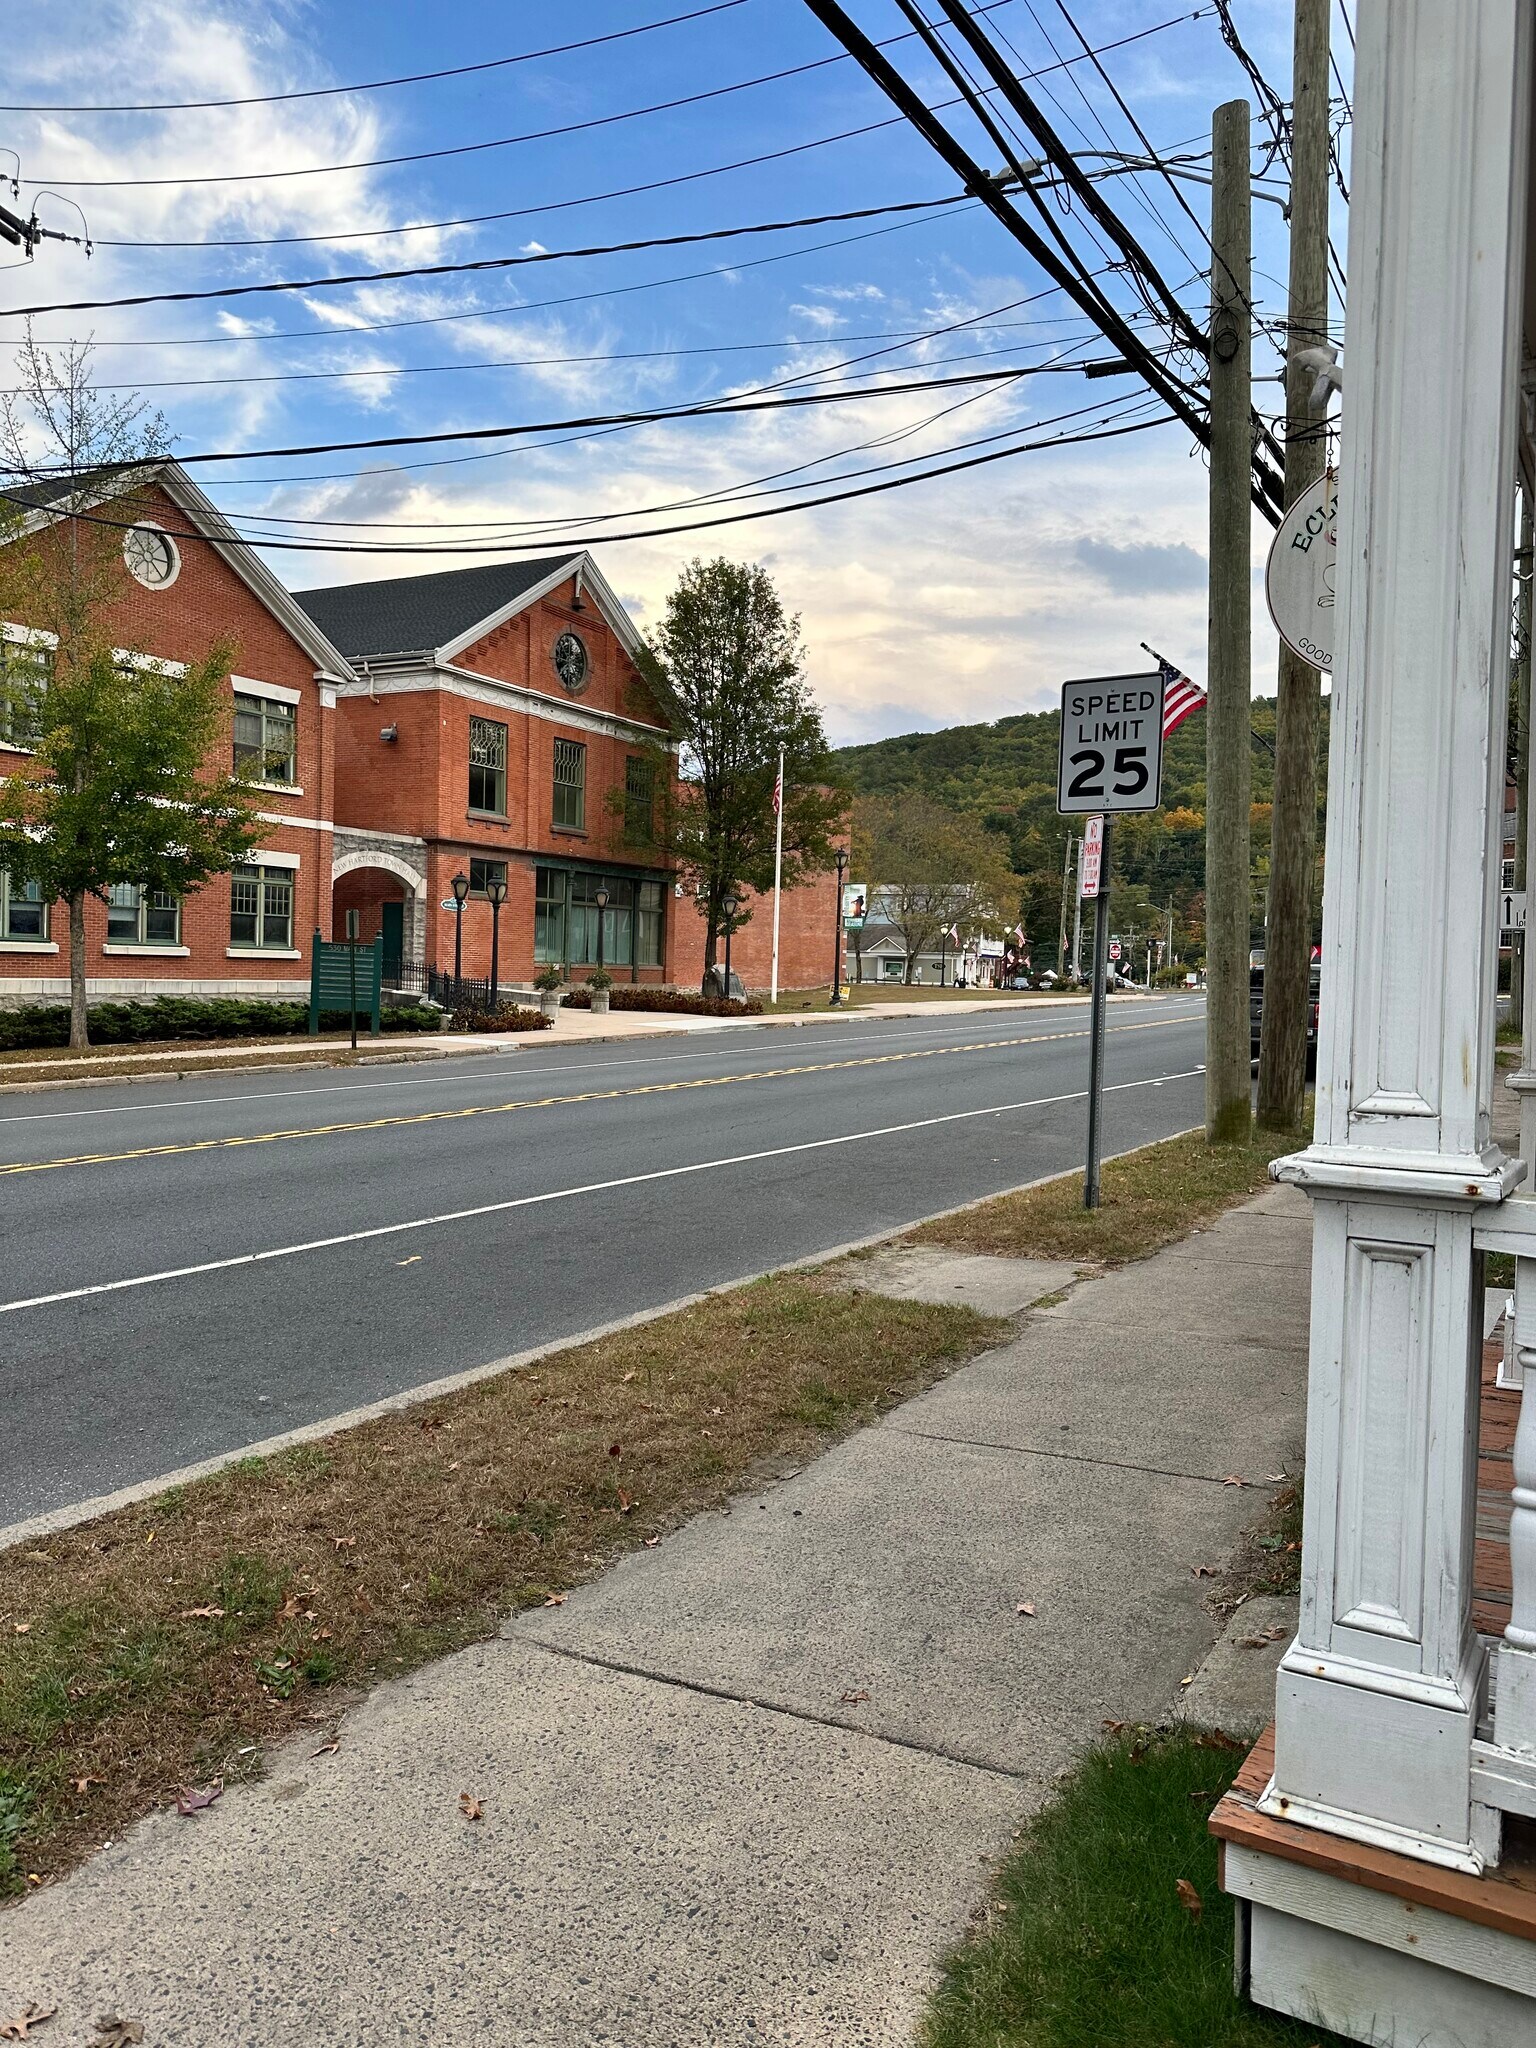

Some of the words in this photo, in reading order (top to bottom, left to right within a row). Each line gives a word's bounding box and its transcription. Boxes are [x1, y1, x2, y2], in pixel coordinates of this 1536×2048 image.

[1298, 637, 1333, 664] GOOD
[1070, 691, 1155, 717] SPEED
[1078, 719, 1144, 743] LIMIT
[1068, 747, 1149, 797] 25
[1090, 824, 1097, 838] NO
[1085, 841, 1101, 856] PARKING
[333, 861, 347, 874] NEW
[348, 855, 383, 866] HARTFORD
[384, 857, 402, 871] TOWN
[402, 867, 417, 882] HALL
[359, 946, 367, 954] ST
